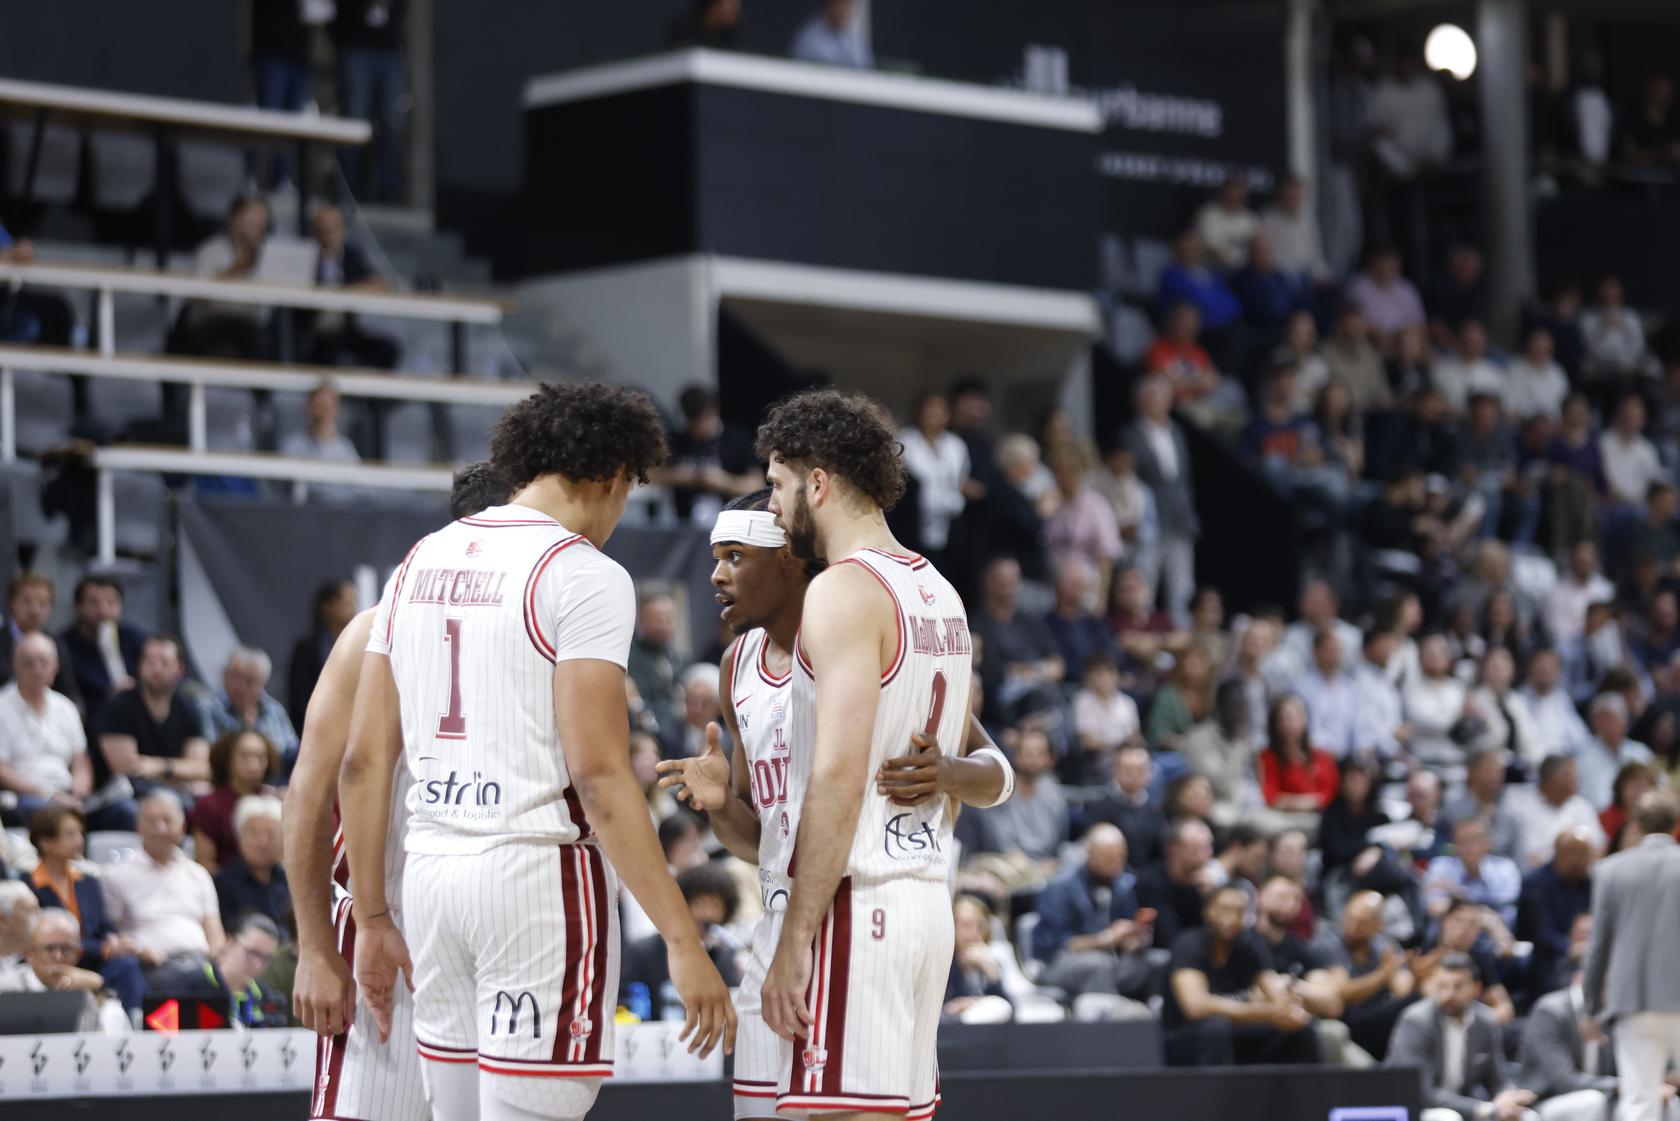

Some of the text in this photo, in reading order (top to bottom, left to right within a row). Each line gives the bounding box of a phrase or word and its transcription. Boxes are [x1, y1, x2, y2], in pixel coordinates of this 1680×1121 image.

[408, 568, 507, 607] MITCHELL
[435, 616, 467, 740] 1
[773, 728, 788, 751] JL
[750, 757, 792, 815] OU
[872, 908, 886, 942] 9
